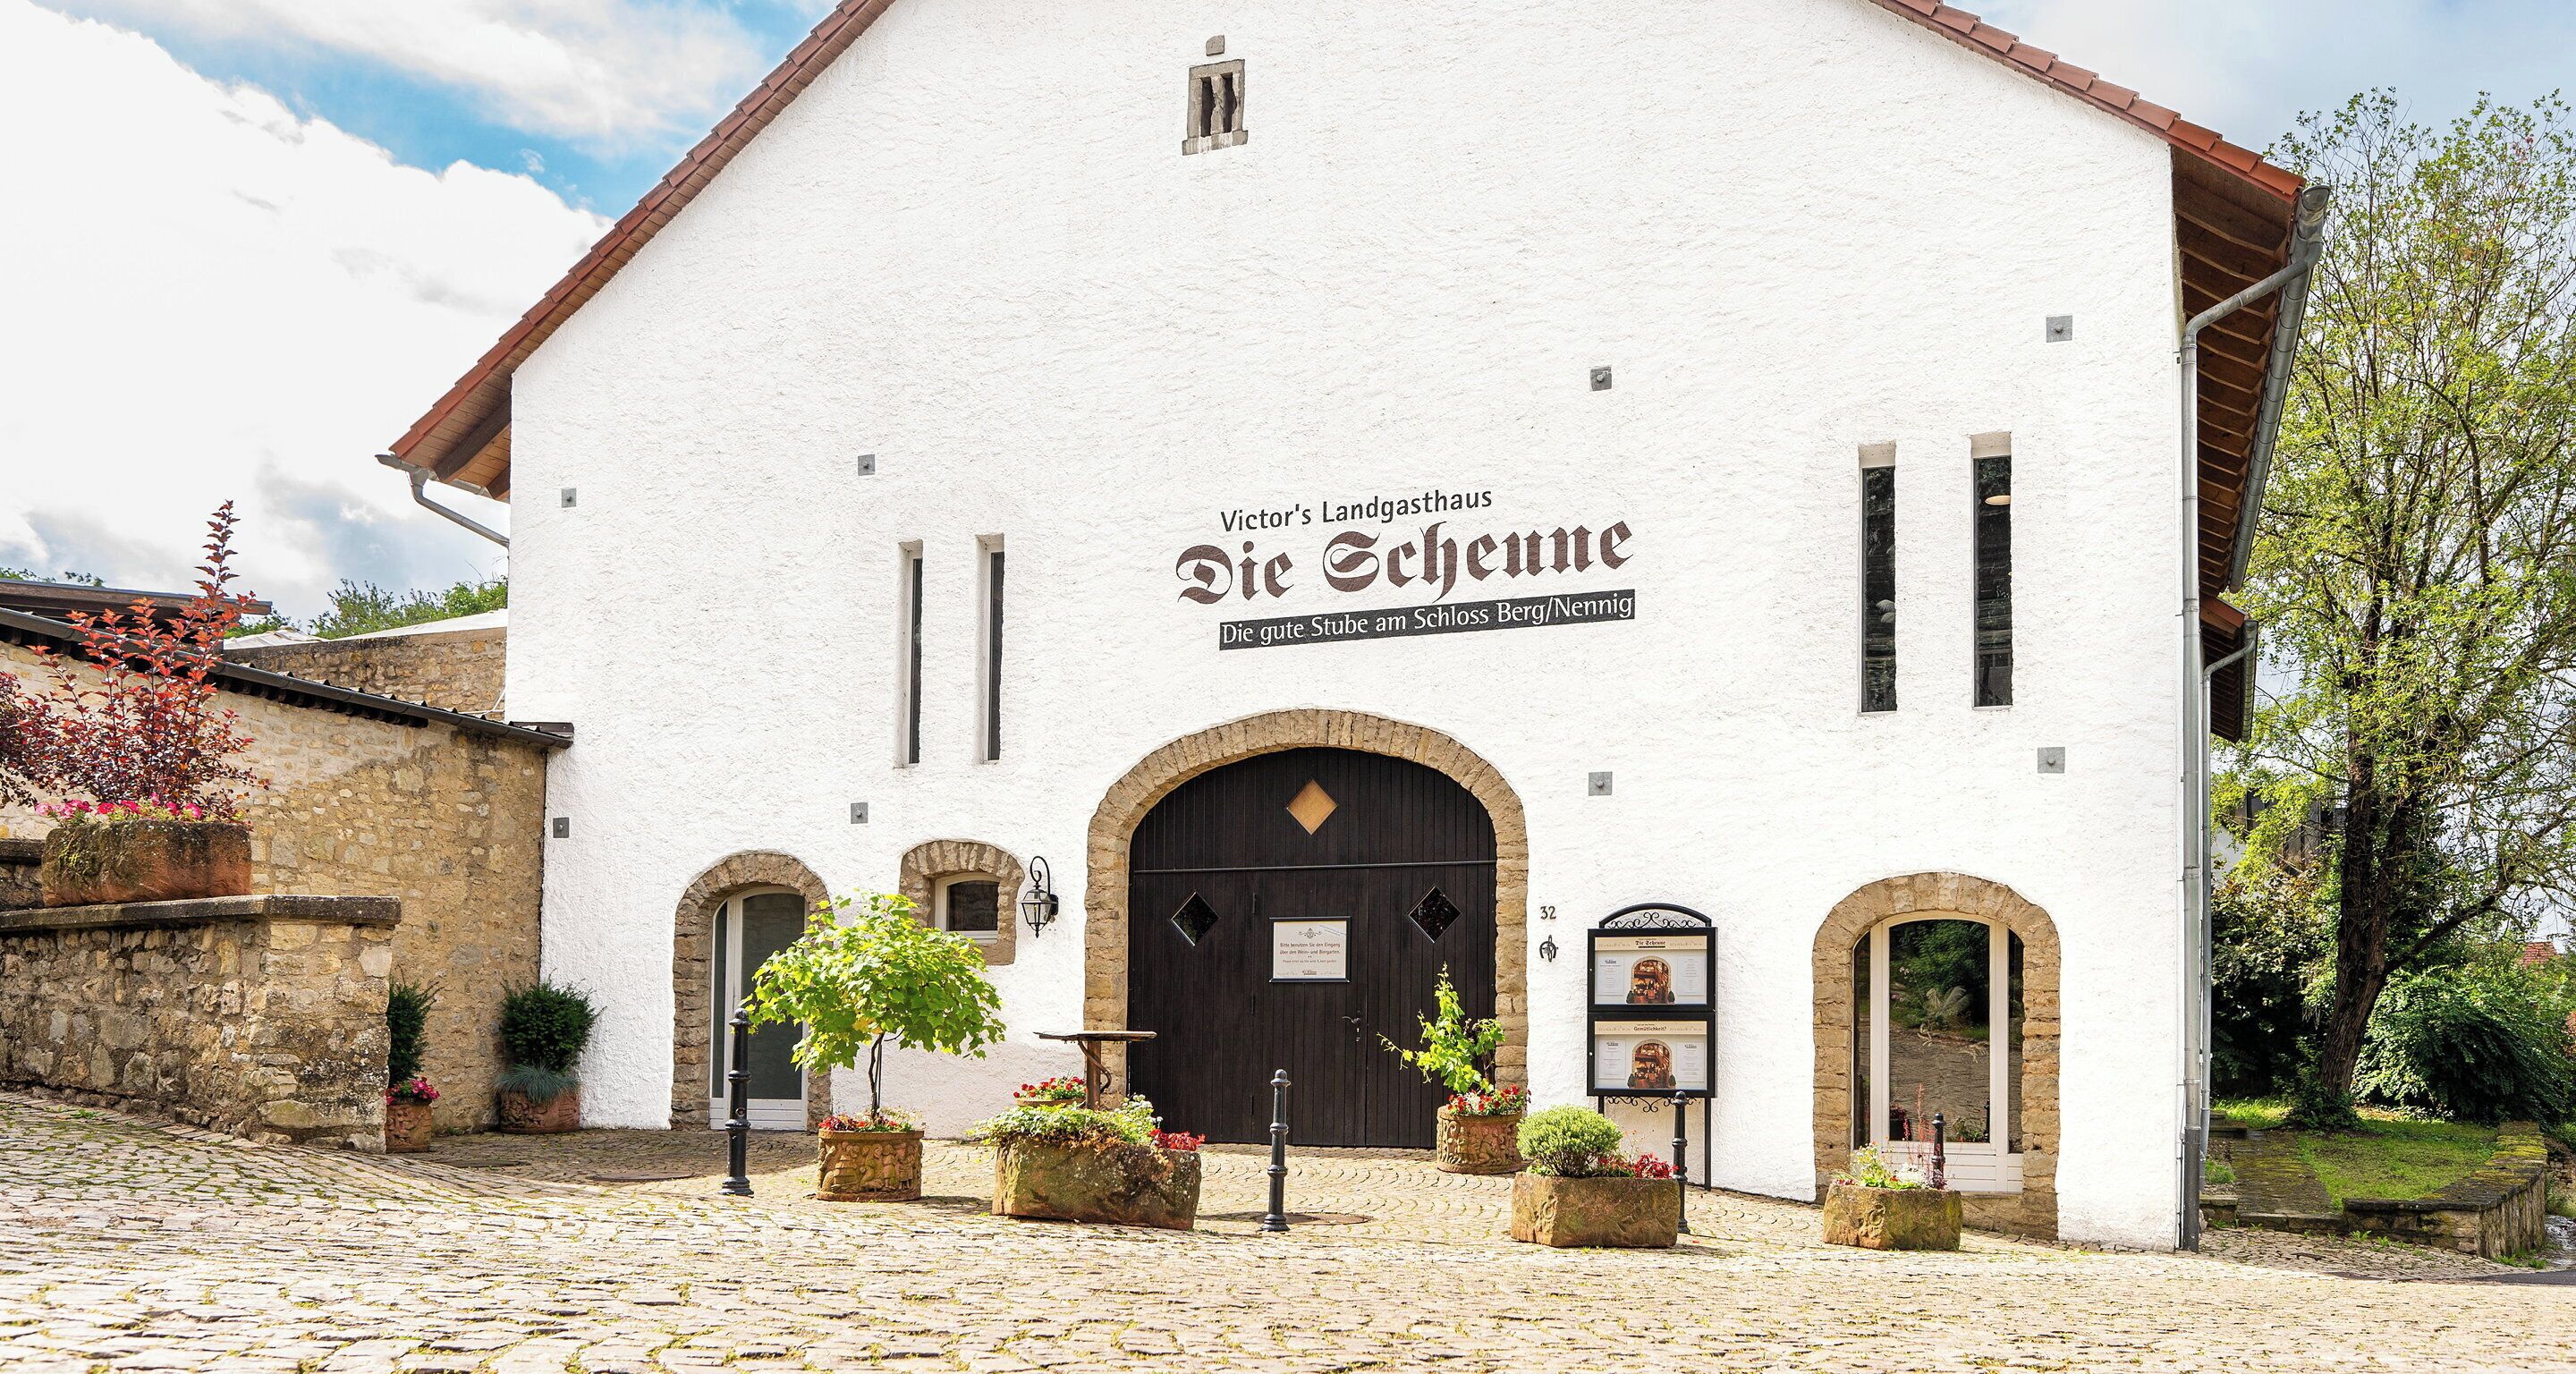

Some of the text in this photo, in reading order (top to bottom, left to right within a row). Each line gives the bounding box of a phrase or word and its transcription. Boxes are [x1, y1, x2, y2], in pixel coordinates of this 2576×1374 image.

[1220, 489, 1493, 532] Victor's Landgasthaus
[1175, 520, 1634, 605] Die Scheune
[1222, 592, 1633, 646] Die gute Stube am Schloss Berg/Nennig
[1539, 905, 1557, 920] 32
